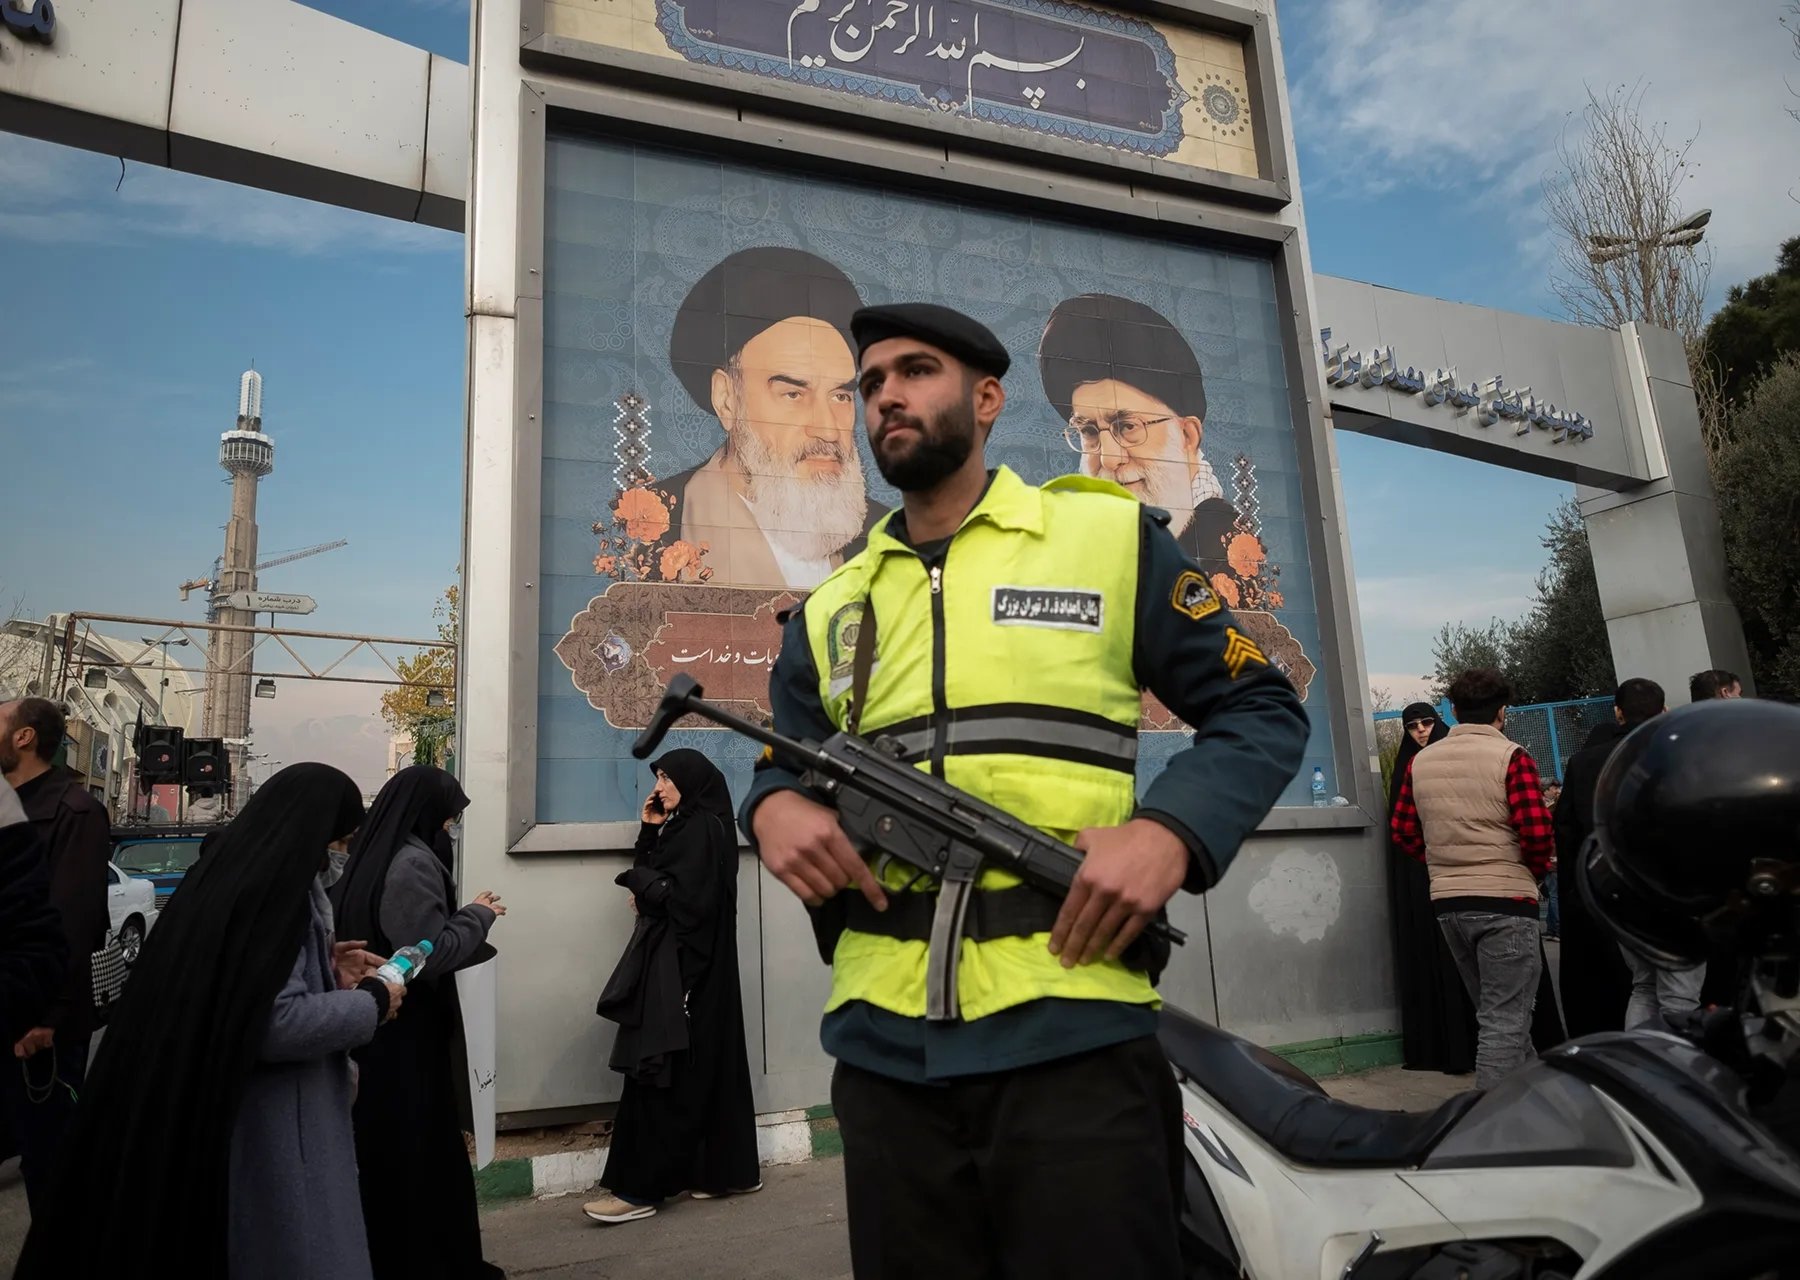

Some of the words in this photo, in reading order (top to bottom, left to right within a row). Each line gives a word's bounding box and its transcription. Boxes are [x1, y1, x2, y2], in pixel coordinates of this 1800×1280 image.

[967, 36, 1087, 118] بسم
[996, 594, 1020, 617] بزرگ
[1019, 596, 1042, 617] تهران
[733, 651, 740, 664] و
